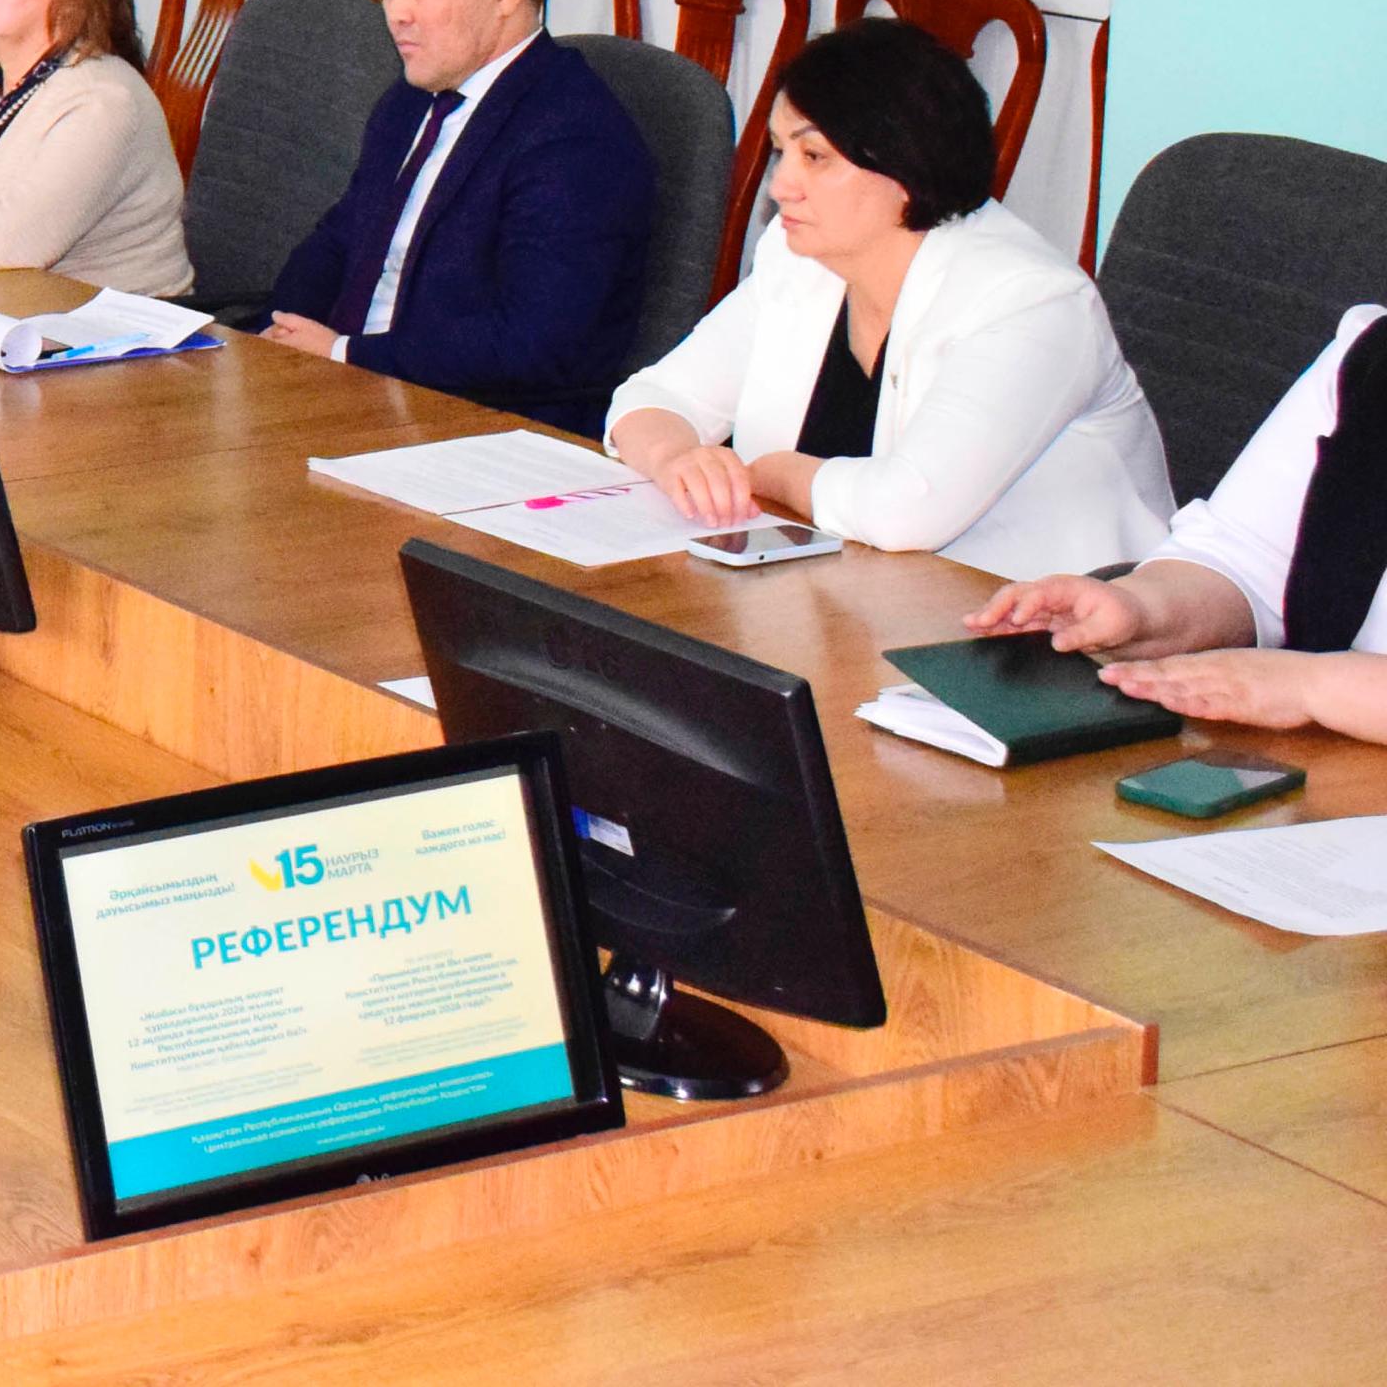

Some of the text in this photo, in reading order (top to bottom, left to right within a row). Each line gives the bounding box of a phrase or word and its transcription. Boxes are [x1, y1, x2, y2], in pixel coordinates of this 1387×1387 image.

[274, 844, 325, 888] 15
[325, 848, 379, 868] НАУРЫЗ
[326, 861, 372, 880] МАРТА
[191, 885, 472, 970] РЕФЕРЕНДУМ
